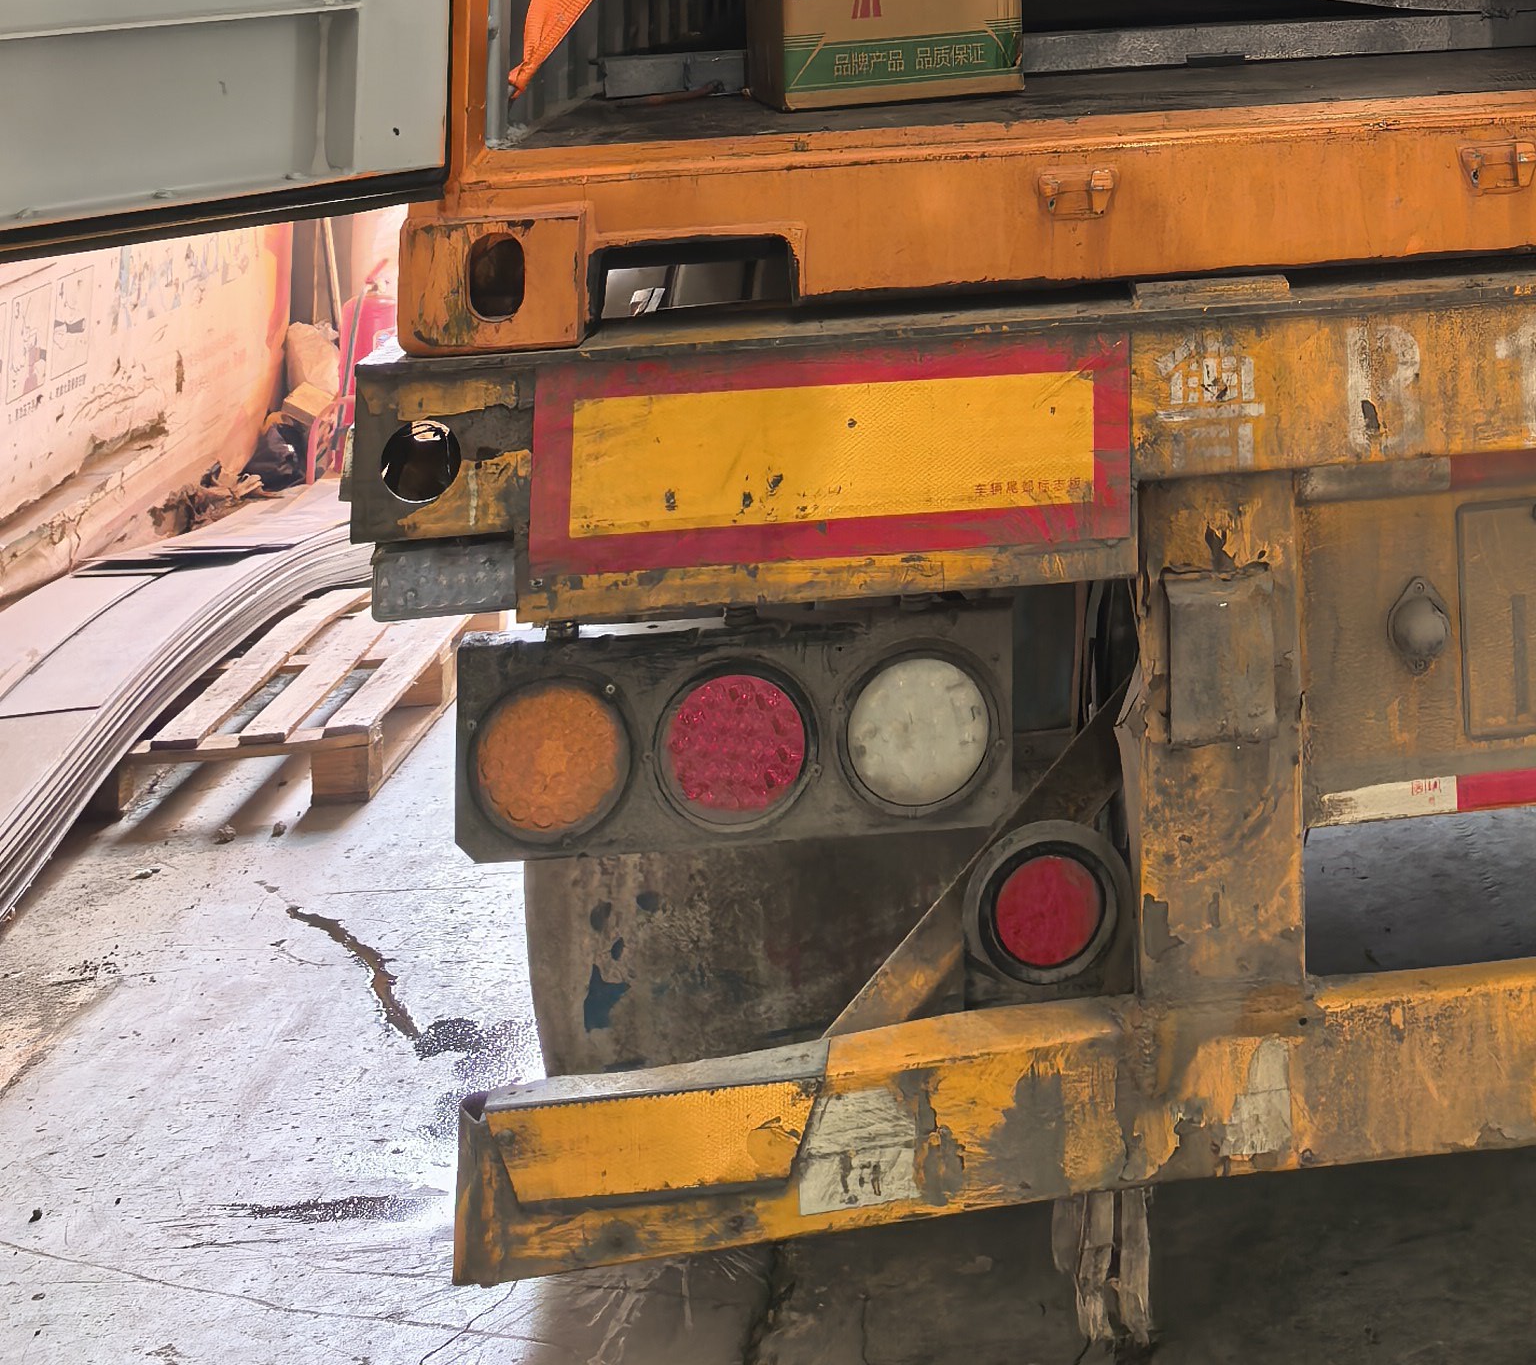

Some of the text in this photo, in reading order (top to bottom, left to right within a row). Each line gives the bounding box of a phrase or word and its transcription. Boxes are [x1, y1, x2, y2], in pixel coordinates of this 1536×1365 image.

[834, 42, 987, 77] 品牌产品 品质保证
